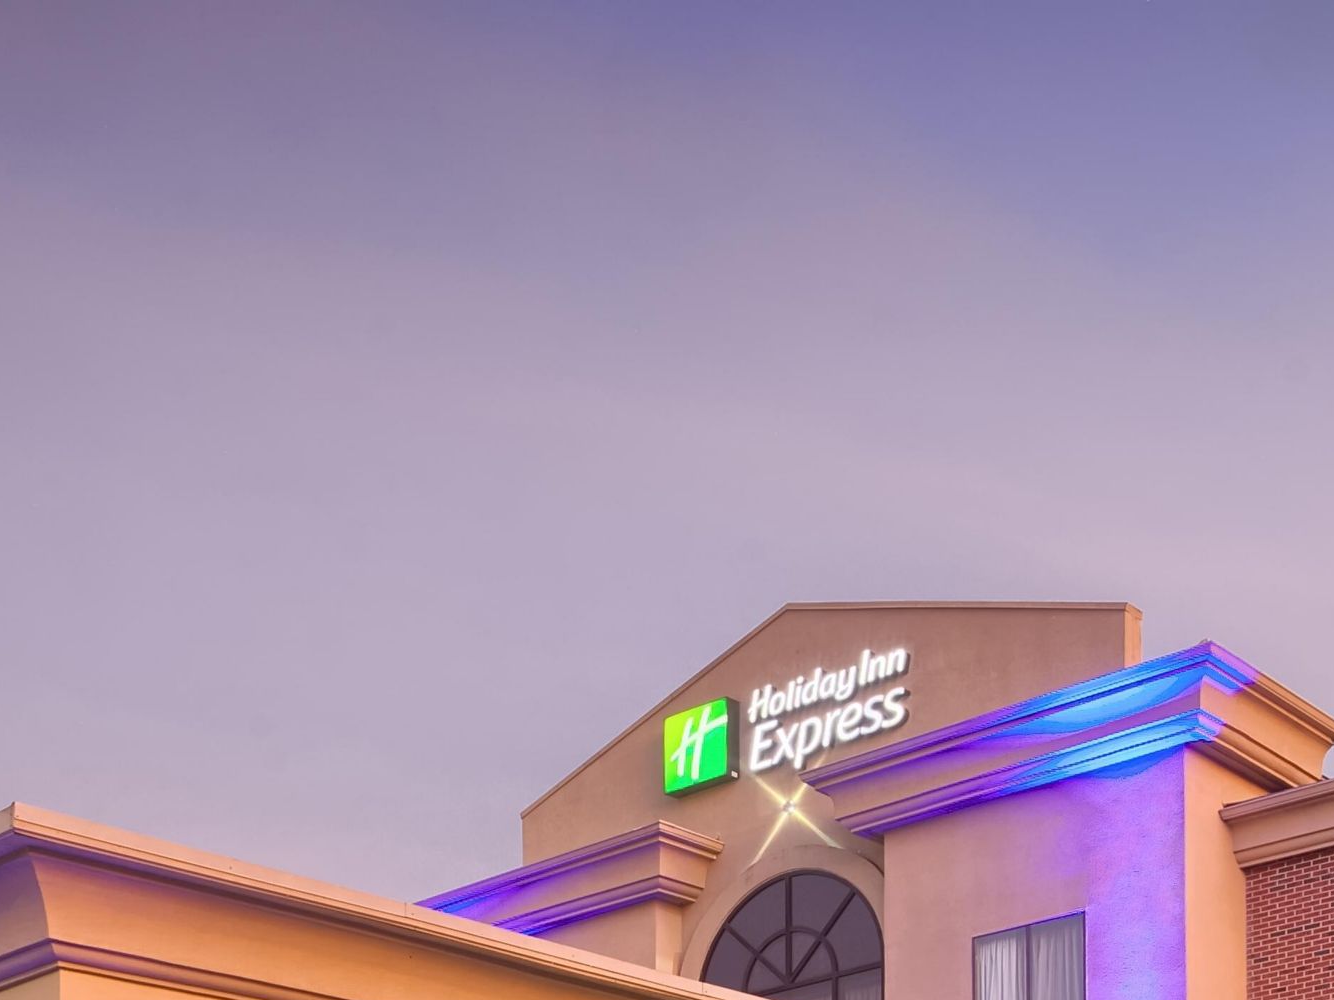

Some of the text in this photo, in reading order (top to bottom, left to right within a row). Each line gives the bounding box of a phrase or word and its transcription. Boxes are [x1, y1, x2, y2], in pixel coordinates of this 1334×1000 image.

[748, 648, 908, 723] Holiday Inn
[749, 687, 908, 773] Express
